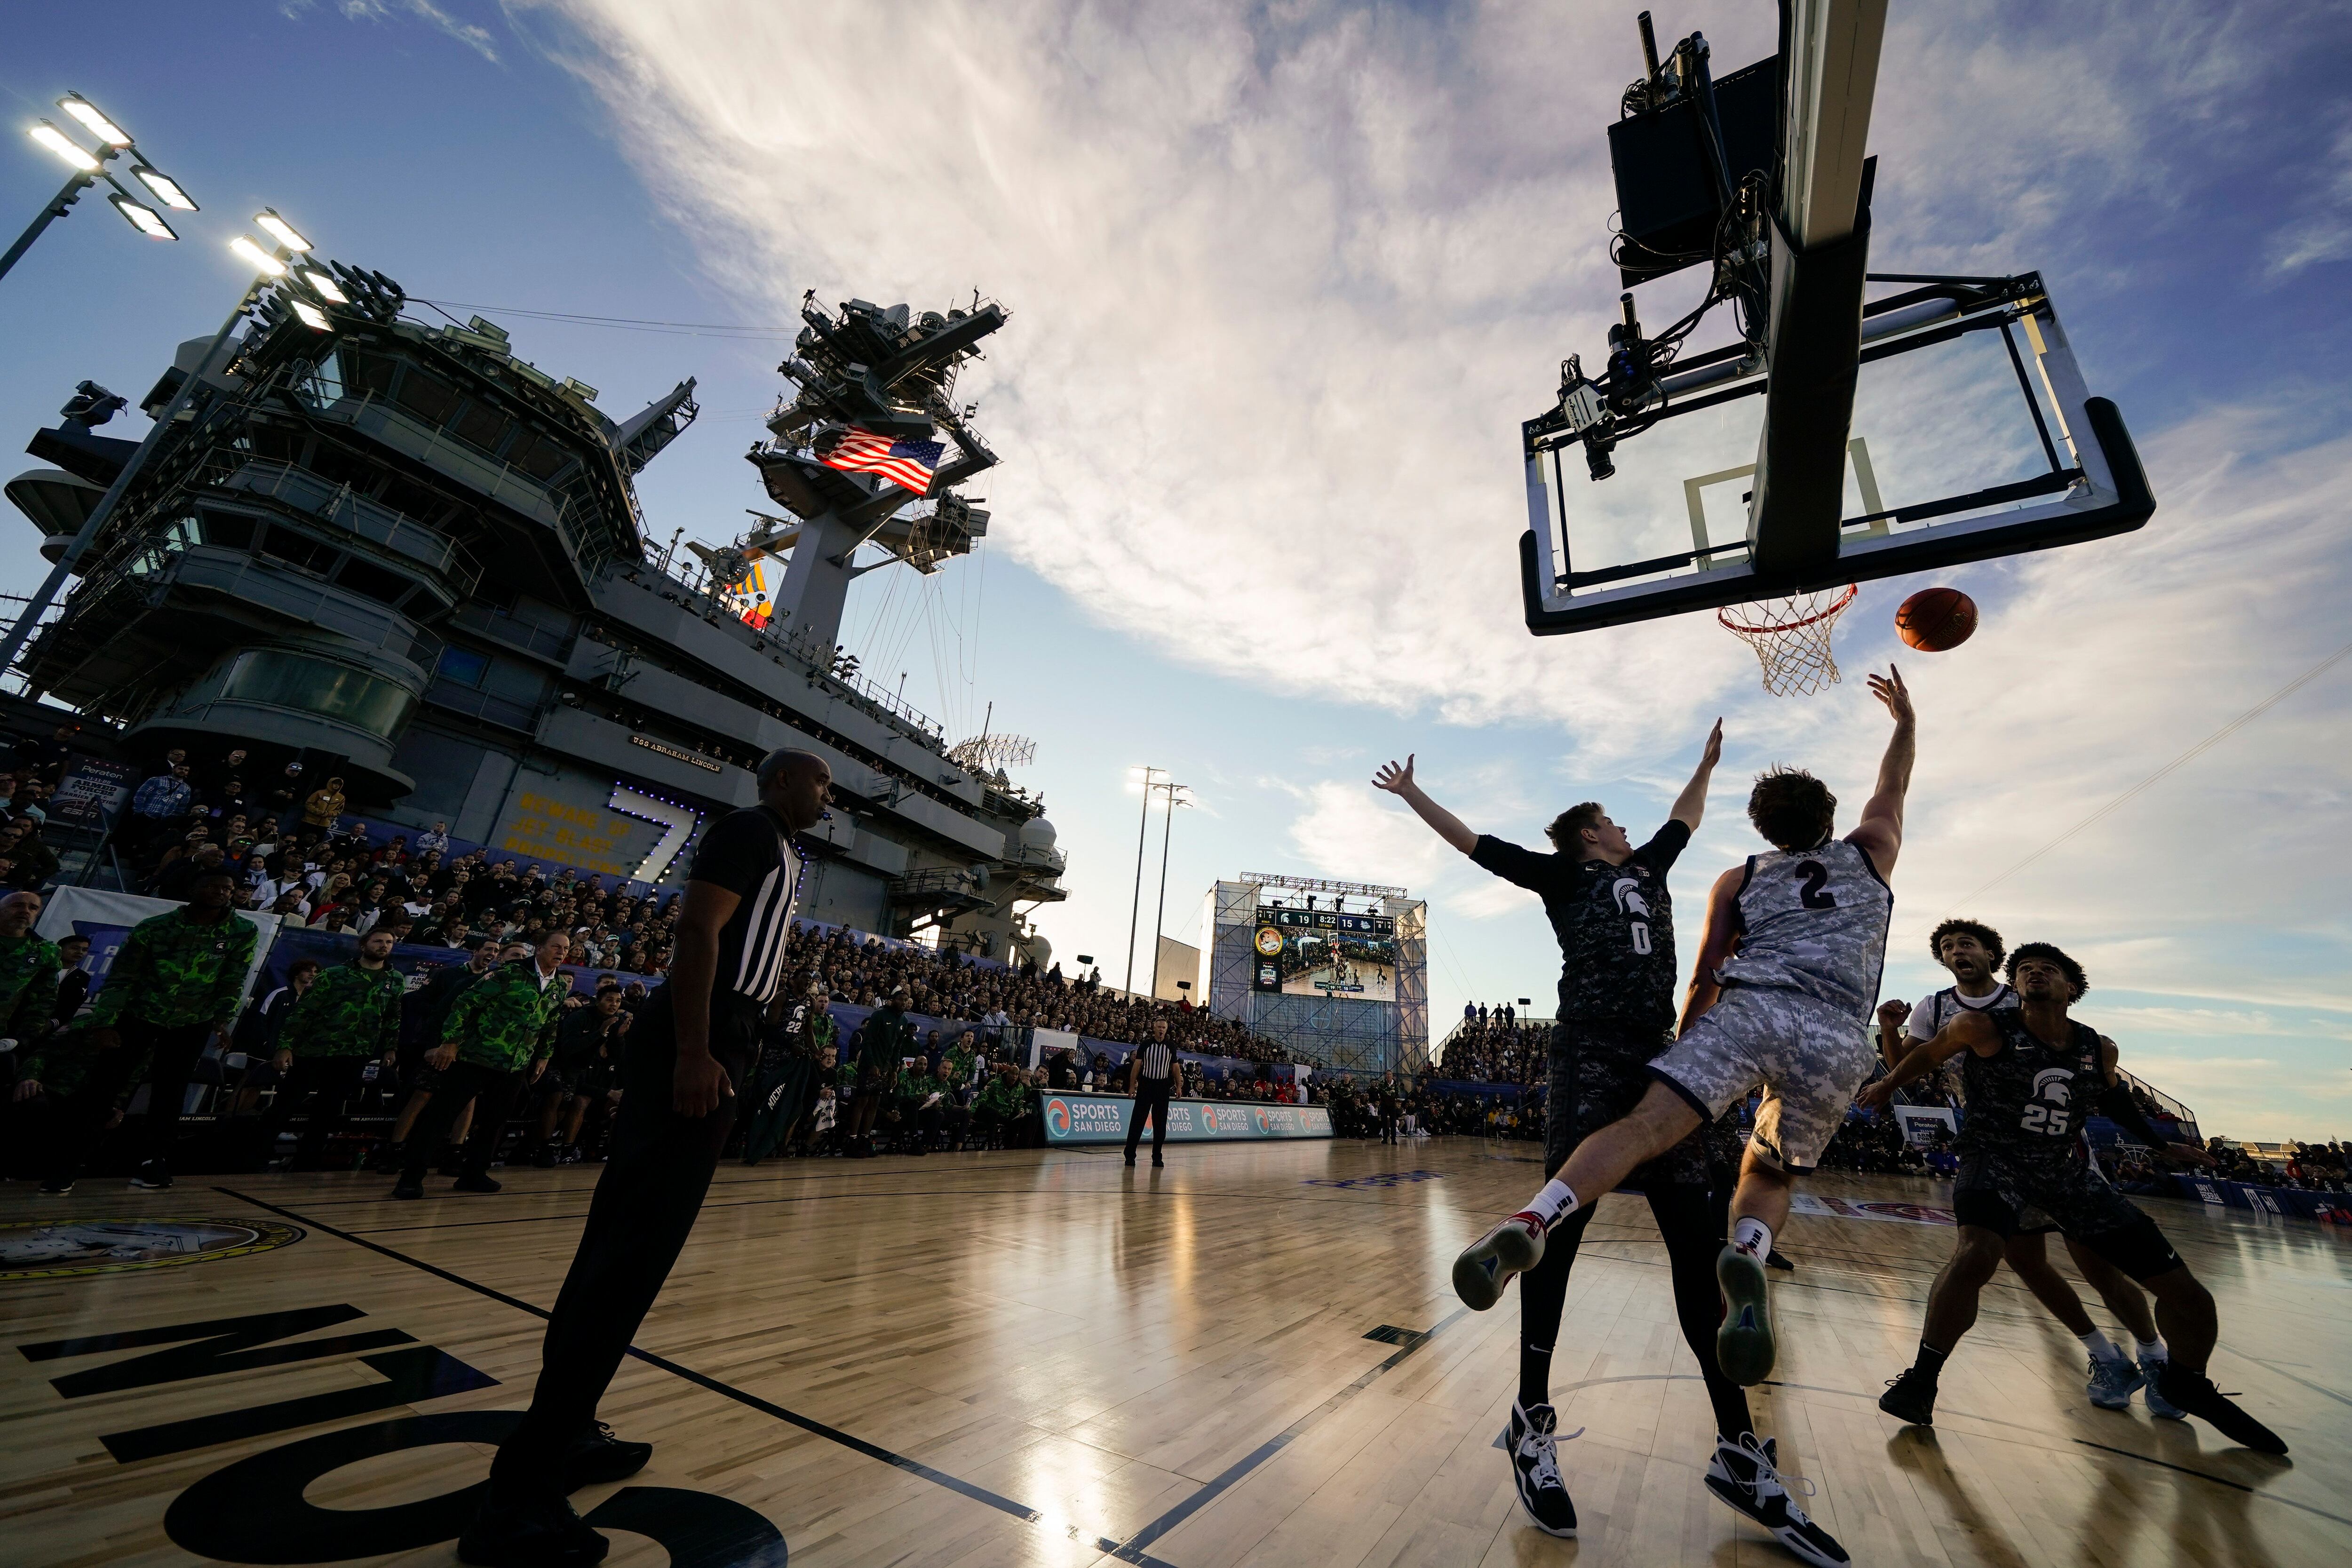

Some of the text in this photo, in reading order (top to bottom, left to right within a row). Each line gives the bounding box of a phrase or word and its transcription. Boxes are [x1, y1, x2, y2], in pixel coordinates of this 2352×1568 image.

[633, 736, 721, 772] USS ABRAHAM LINCOLN
[81, 765, 123, 780] Peraton
[71, 784, 115, 796] FORCES
[73, 780, 117, 792] ARMED
[59, 791, 89, 800] CARRIER
[73, 789, 108, 799] CLASIC
[521, 793, 600, 829] BEWARE
[511, 818, 612, 854] JET BLAST
[1795, 860, 1837, 909] 2
[1299, 915, 1309, 923] 19
[1319, 915, 1336, 924] 8:22
[1342, 919, 1352, 928] 15
[1630, 922, 1653, 955] 0
[786, 1021, 802, 1034] 22
[1072, 1104, 1119, 1120] SPORTS
[1167, 1106, 1191, 1121] ORTS
[1216, 1108, 1247, 1122] SPORTS
[1267, 1111, 1293, 1122] SPORTS
[1309, 1112, 1330, 1122] SPORTS
[1074, 1121, 1121, 1132] SAN DIEGO
[1219, 1122, 1249, 1131] SAN DIEGO
[2020, 1104, 2070, 1136] 25
[1172, 1122, 1192, 1132] DIEGO
[2195, 1184, 2210, 1192] NAVY
[2200, 1191, 2223, 1201] FEDERAL
